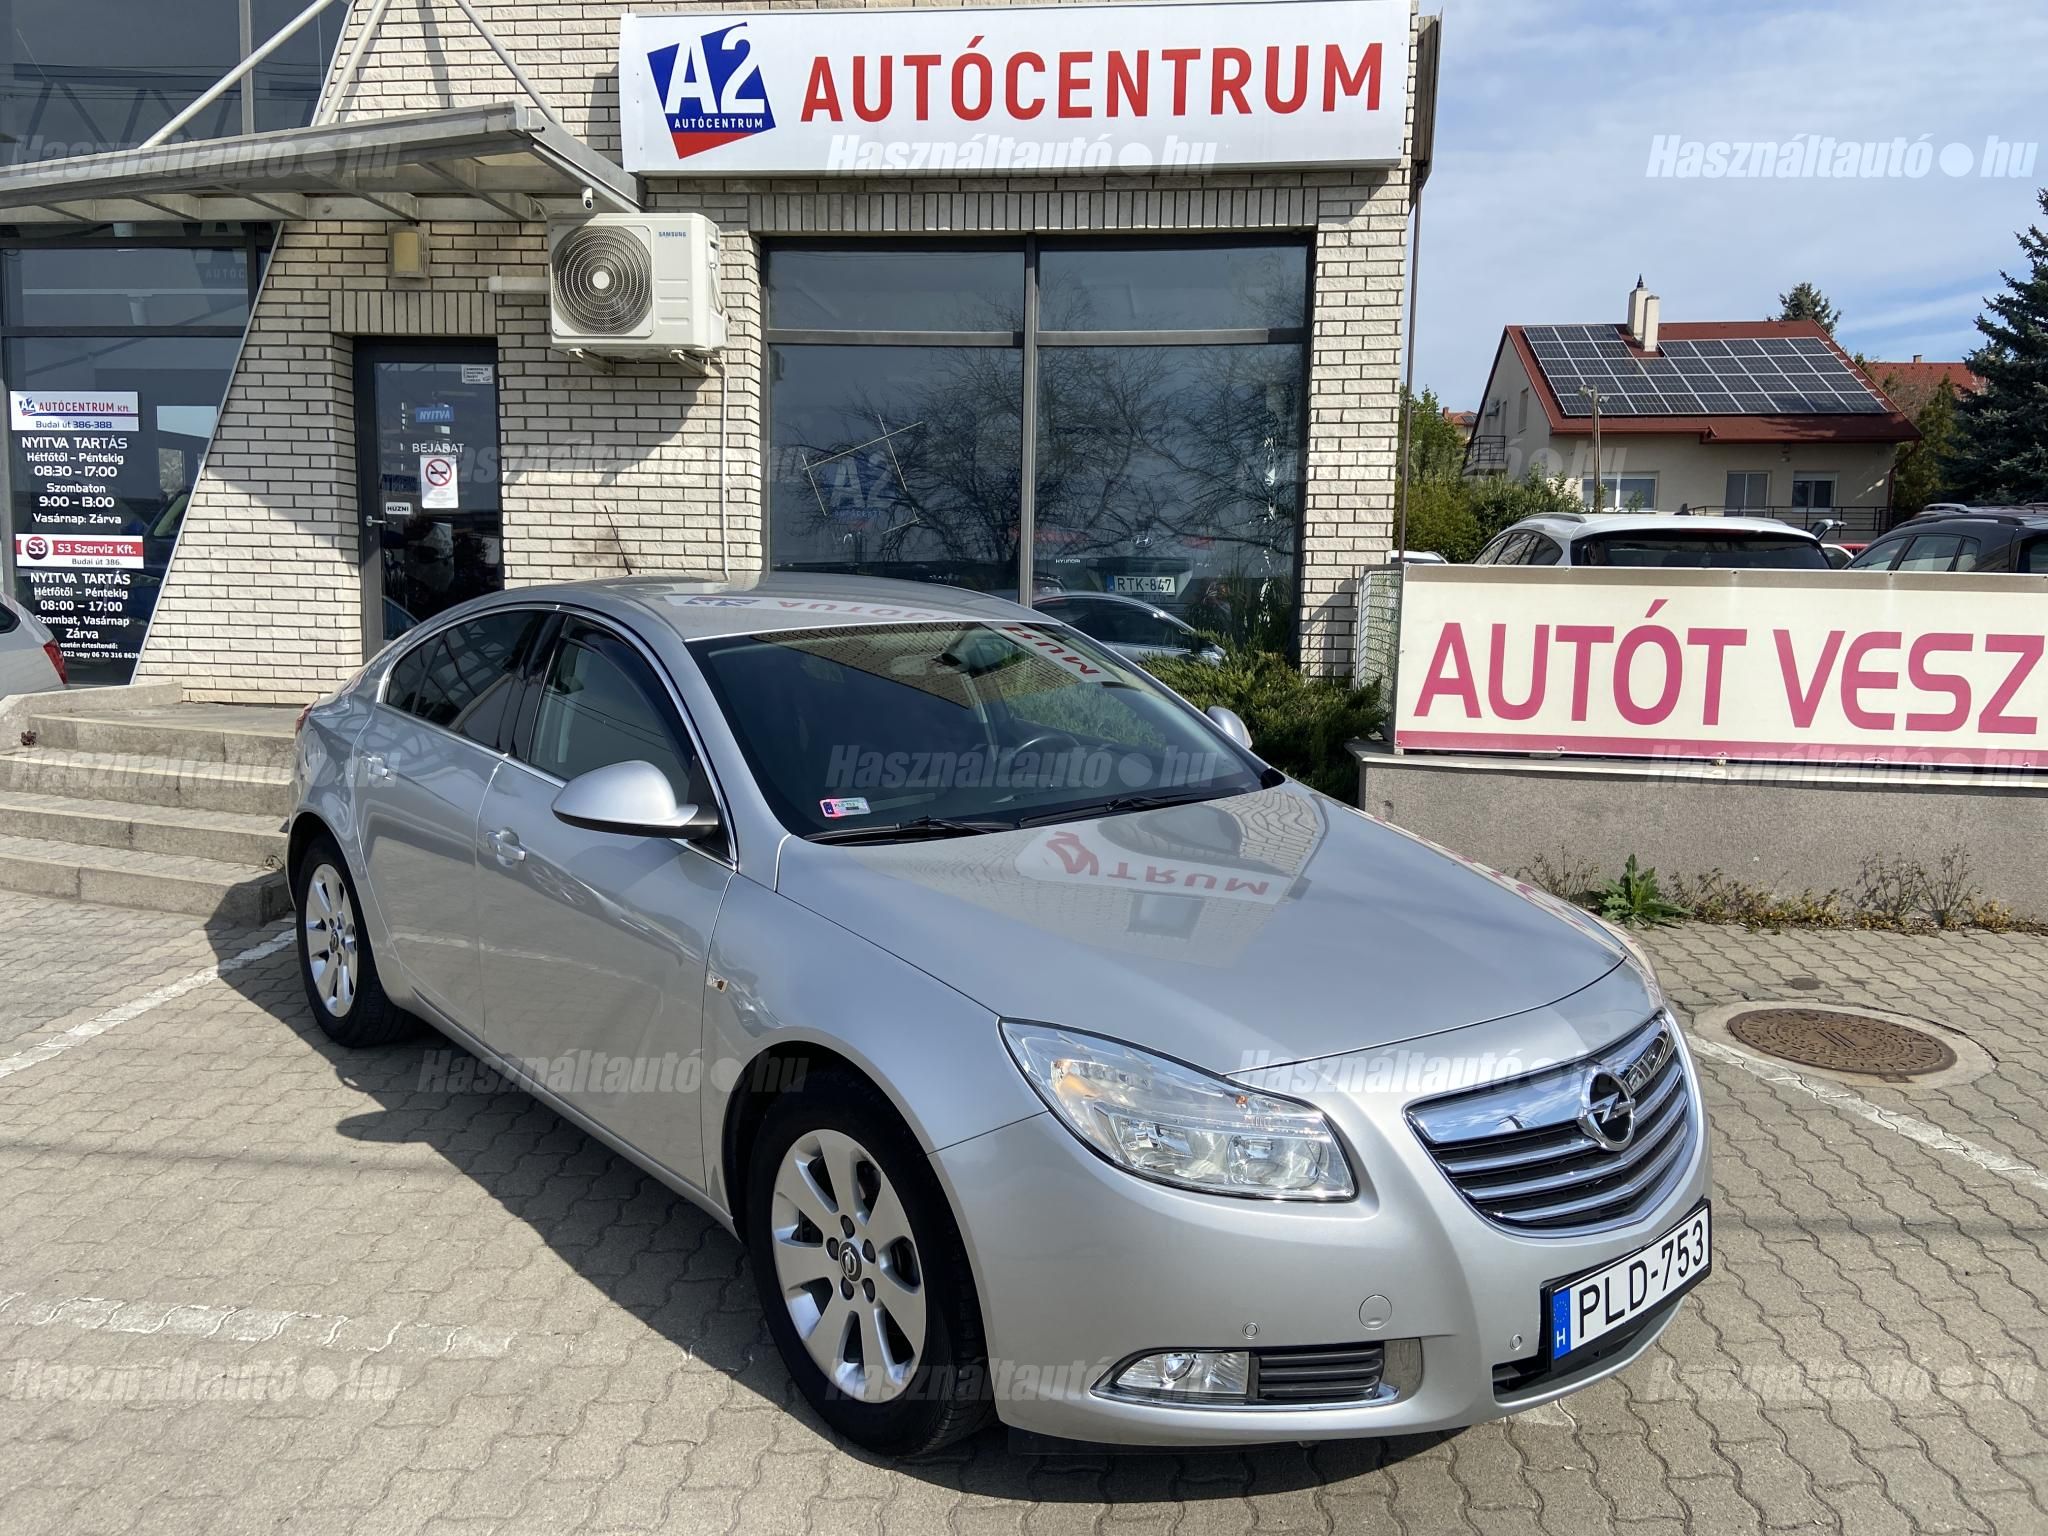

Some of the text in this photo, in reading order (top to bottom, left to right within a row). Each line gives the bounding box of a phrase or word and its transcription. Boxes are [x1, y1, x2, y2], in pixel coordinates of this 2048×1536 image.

[664, 25, 765, 114] A2
[802, 36, 1382, 122] AUTÓCENTRUM
[674, 116, 763, 128] AUTÓCENTRUM
[38, 400, 114, 412] AUTÓCENTRUM
[419, 410, 450, 420] NYITVA
[36, 420, 60, 429] Budai
[73, 421, 112, 429] 386-388
[22, 435, 128, 449] NYITVA TARTÁS
[412, 441, 464, 453] BEJÁRAT
[27, 452, 68, 462] Hétfőtől
[79, 453, 124, 464] Péntekig
[34, 466, 72, 477] 08:30
[85, 466, 118, 477] 17:00
[47, 483, 106, 493] Szombaton
[39, 496, 69, 507] 9:00
[82, 497, 115, 508] 13:00
[33, 513, 122, 526] Vasárnap: Zárva
[28, 540, 46, 555] S3
[58, 544, 136, 555] S3 Szerviz Kft.
[72, 558, 93, 566] Budai
[30, 571, 131, 585] NYITVA TARTÁS
[1118, 576, 1172, 591] RTK-847
[34, 587, 73, 597] Hétfőtől
[85, 588, 128, 600] Péntekig
[40, 600, 74, 611] 08:00
[89, 601, 123, 611] 17:00
[83, 616, 130, 627] Vasárnap
[66, 628, 99, 639] Zárva
[1413, 599, 2046, 734] AUTÓT VESZ
[1578, 1219, 1704, 1339] PLD-753
[1556, 1327, 1566, 1348] H
